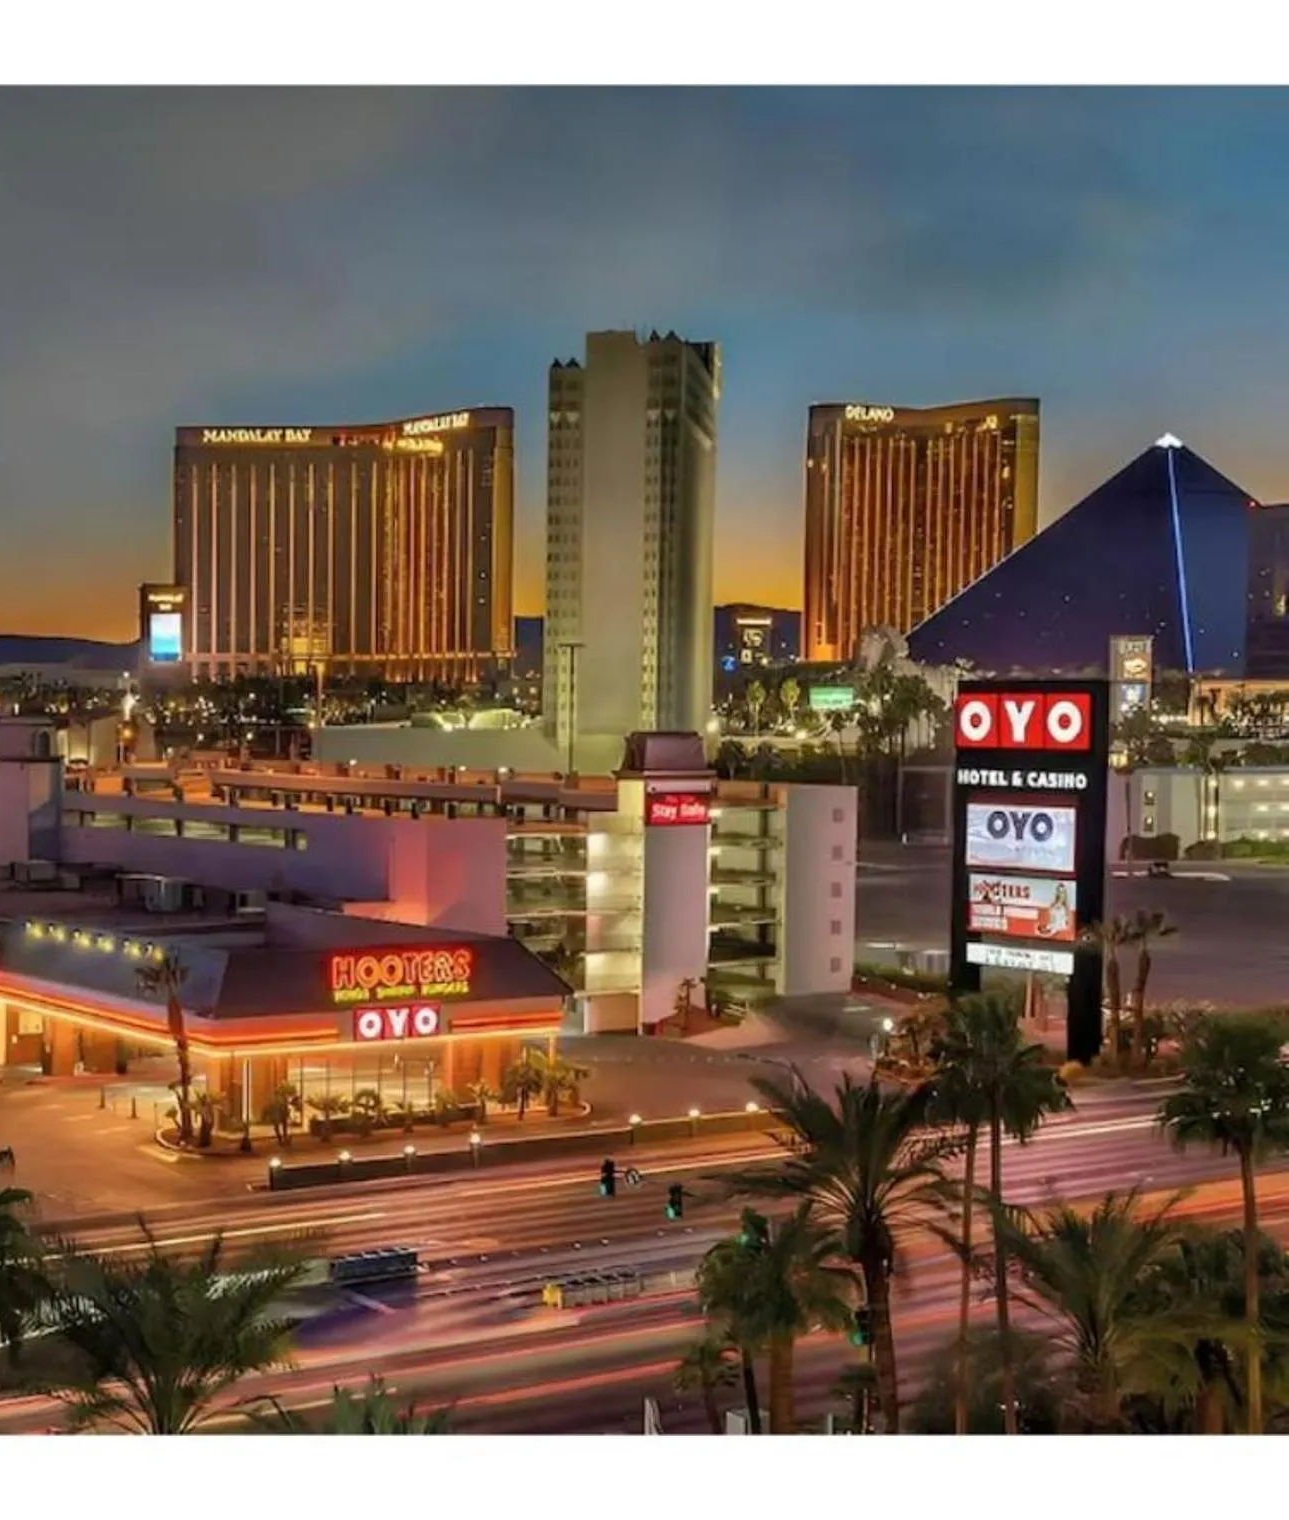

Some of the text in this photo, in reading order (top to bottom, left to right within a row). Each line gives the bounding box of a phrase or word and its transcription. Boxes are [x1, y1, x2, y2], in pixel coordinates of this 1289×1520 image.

[960, 700, 1082, 743] OYO
[957, 769, 1008, 786] HOTEL
[1027, 772, 1088, 790] CASINO
[986, 811, 1054, 842] OYO
[332, 949, 472, 990] HOOTERS
[358, 1007, 438, 1038] OYO
